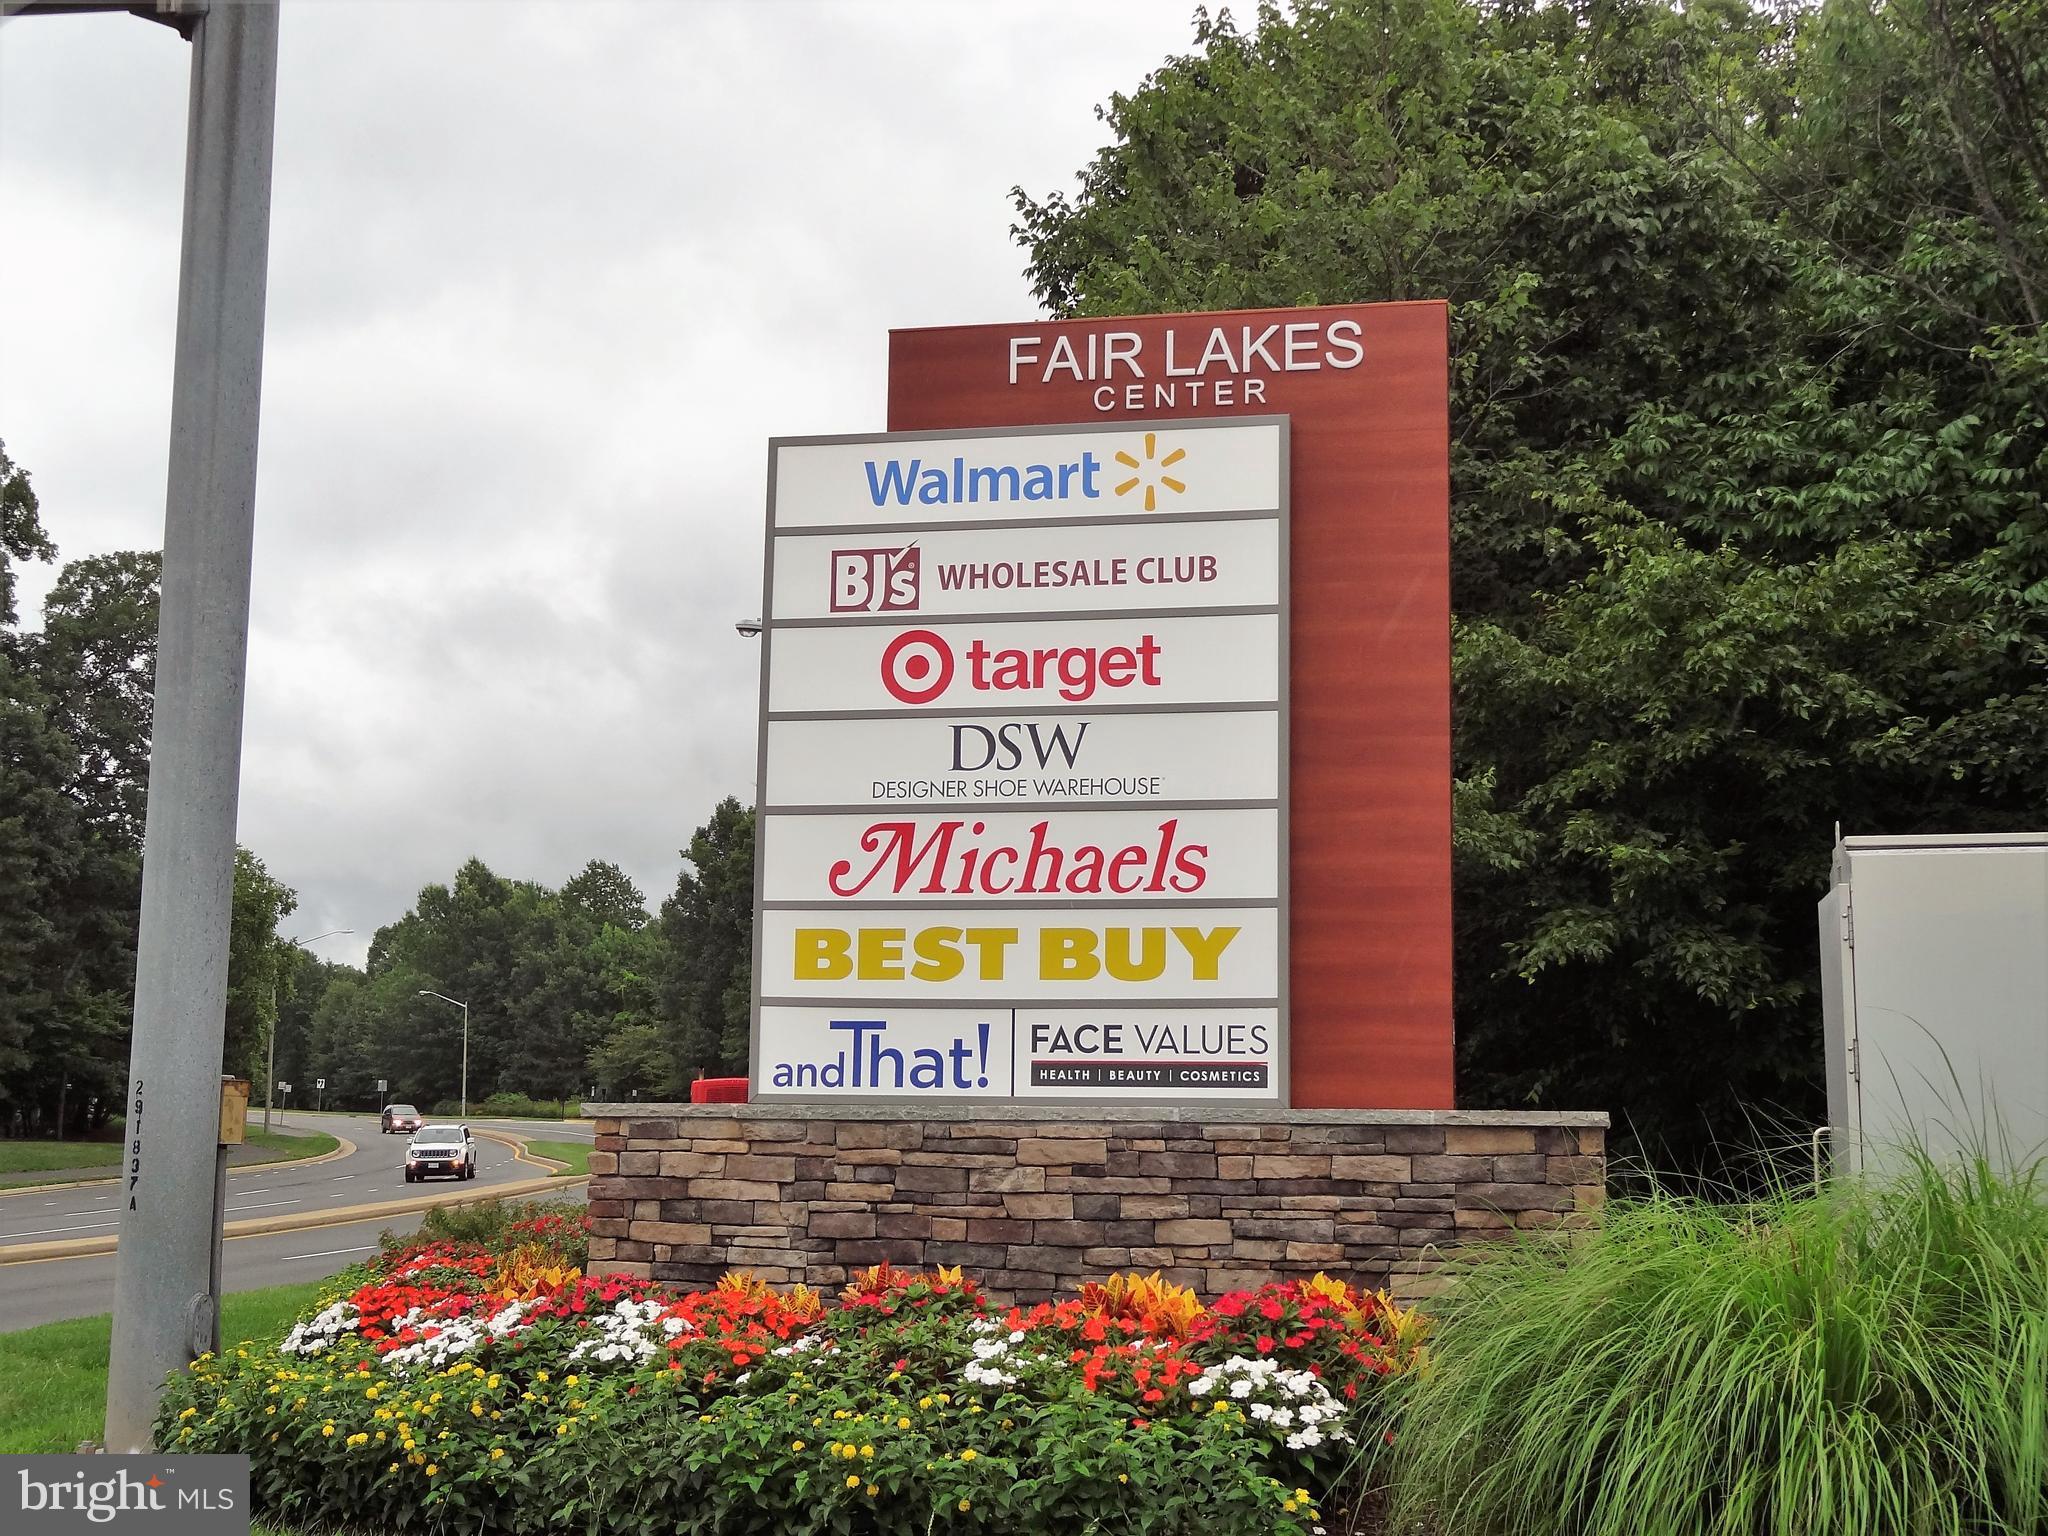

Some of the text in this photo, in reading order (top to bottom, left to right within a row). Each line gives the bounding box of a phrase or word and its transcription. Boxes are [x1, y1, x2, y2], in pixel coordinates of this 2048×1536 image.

[1008, 319, 1365, 385] FAIR LAKES
[1093, 378, 1267, 412] CENTER
[864, 451, 1101, 507] Walmart
[937, 557, 1128, 592] WHOLESALE
[1135, 554, 1218, 585] CLUB
[966, 634, 1162, 703] target
[947, 721, 1092, 772] DSW
[871, 776, 1161, 799] DESIGNER SHOE WAREHOUSE
[828, 818, 1209, 898] Michaels
[793, 925, 1242, 982] BEST BUY
[1030, 1023, 1270, 1056] FACE VALUES
[1039, 1068, 1261, 1083] HEALTH BEAUTY COSMETICS
